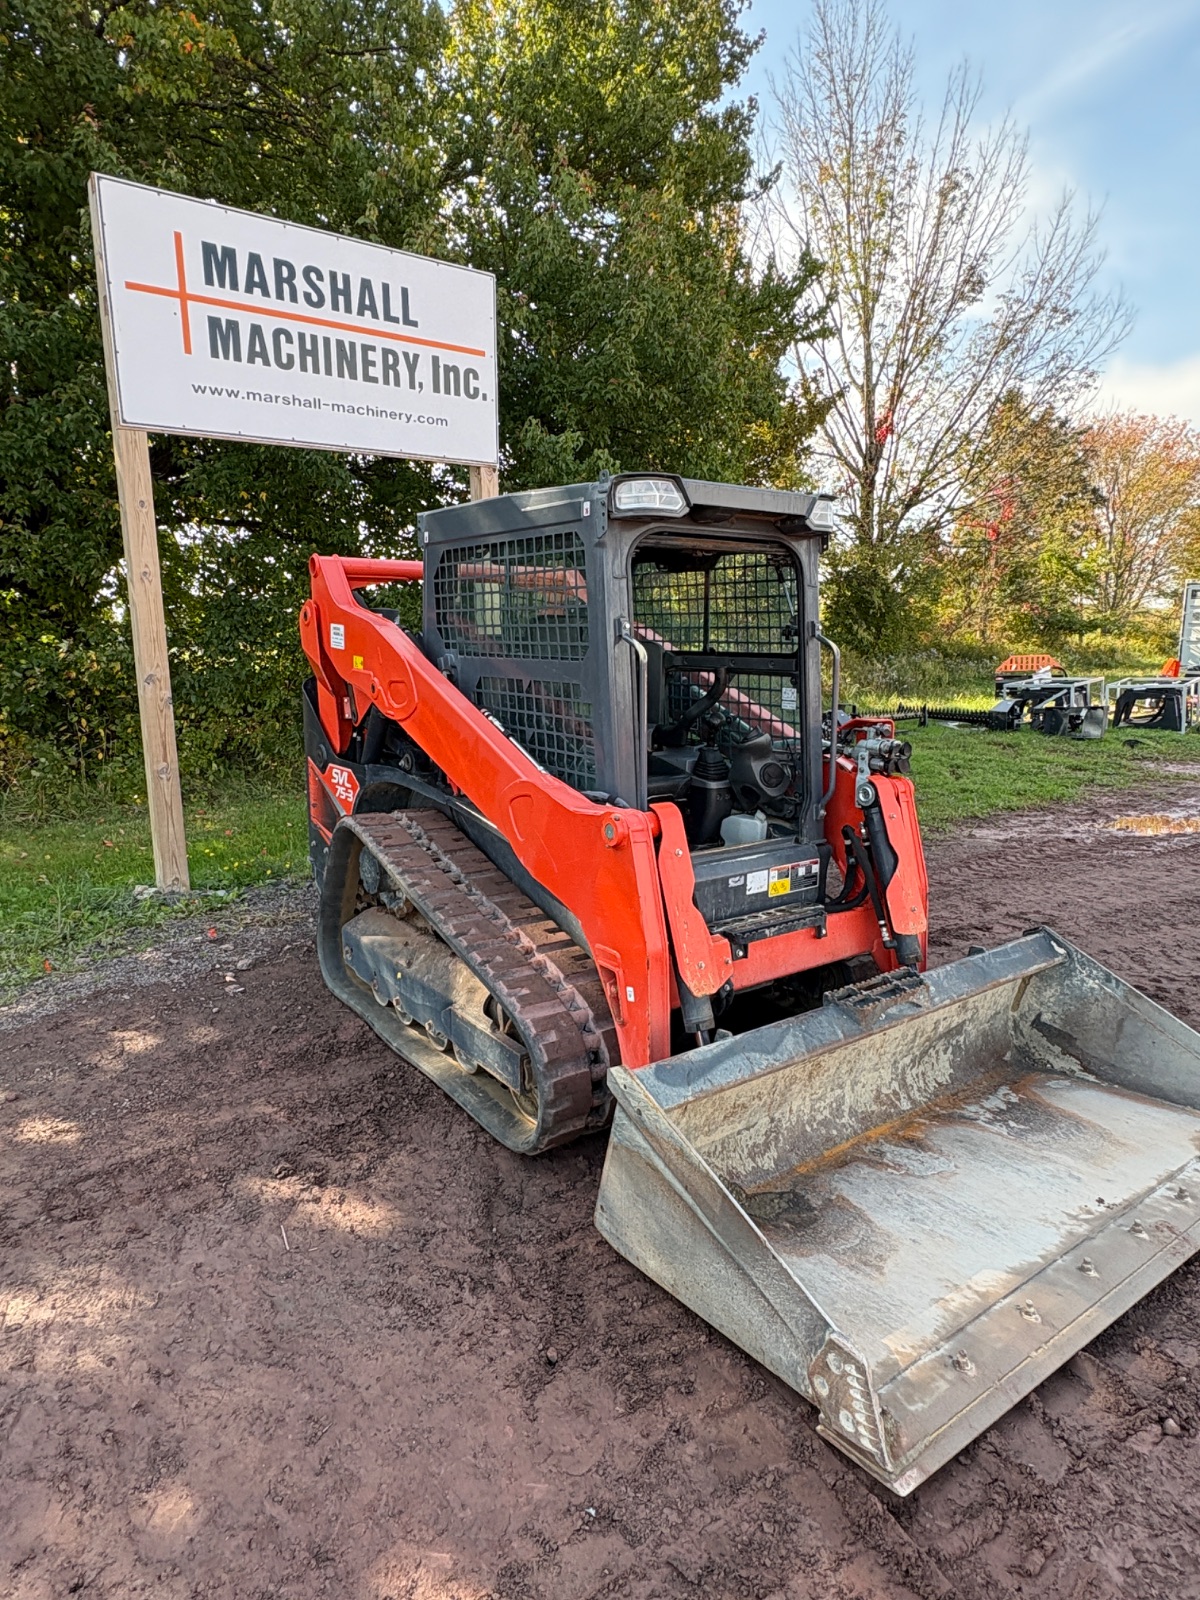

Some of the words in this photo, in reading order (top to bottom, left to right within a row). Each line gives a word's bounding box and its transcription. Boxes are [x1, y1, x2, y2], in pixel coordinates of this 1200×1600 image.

[202, 240, 419, 328] MARSHALL
[206, 315, 424, 394] MACHINERY,
[431, 354, 488, 402] Inc.
[191, 383, 449, 428] www.marshall-machinery.com
[331, 768, 352, 788] SVL
[335, 785, 354, 802] 75-3
